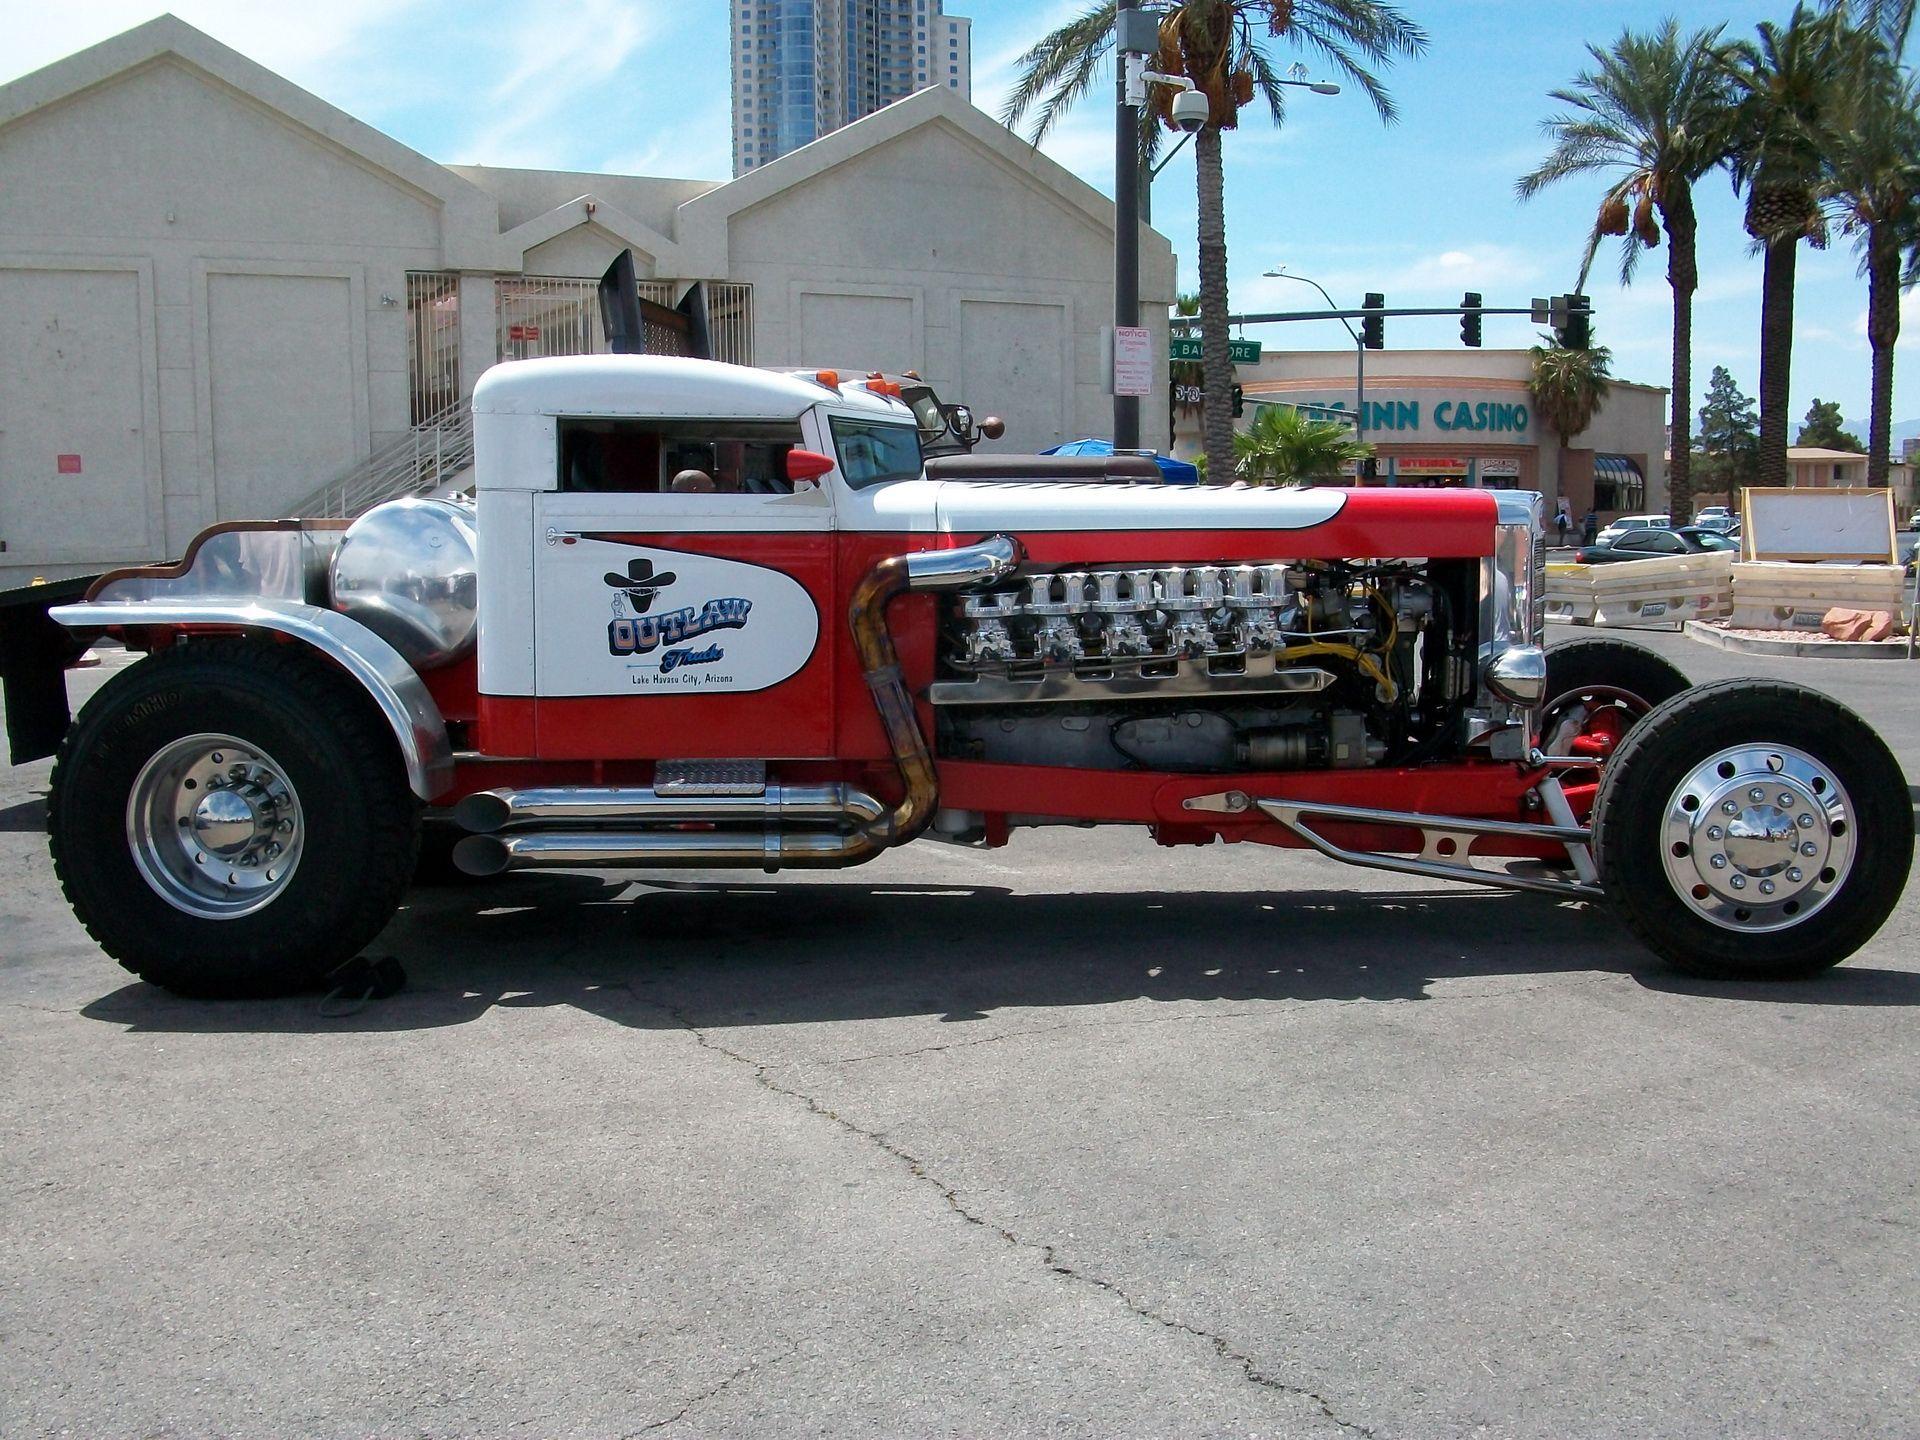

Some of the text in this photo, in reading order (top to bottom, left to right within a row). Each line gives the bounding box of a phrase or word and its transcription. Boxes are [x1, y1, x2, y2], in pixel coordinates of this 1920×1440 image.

[1360, 401, 1419, 431] INN
[1433, 401, 1528, 432] CASINO
[608, 598, 753, 656] OUTLAW
[659, 643, 725, 674] Trucks
[632, 673, 733, 686] Lake Havasu City, Arizona
